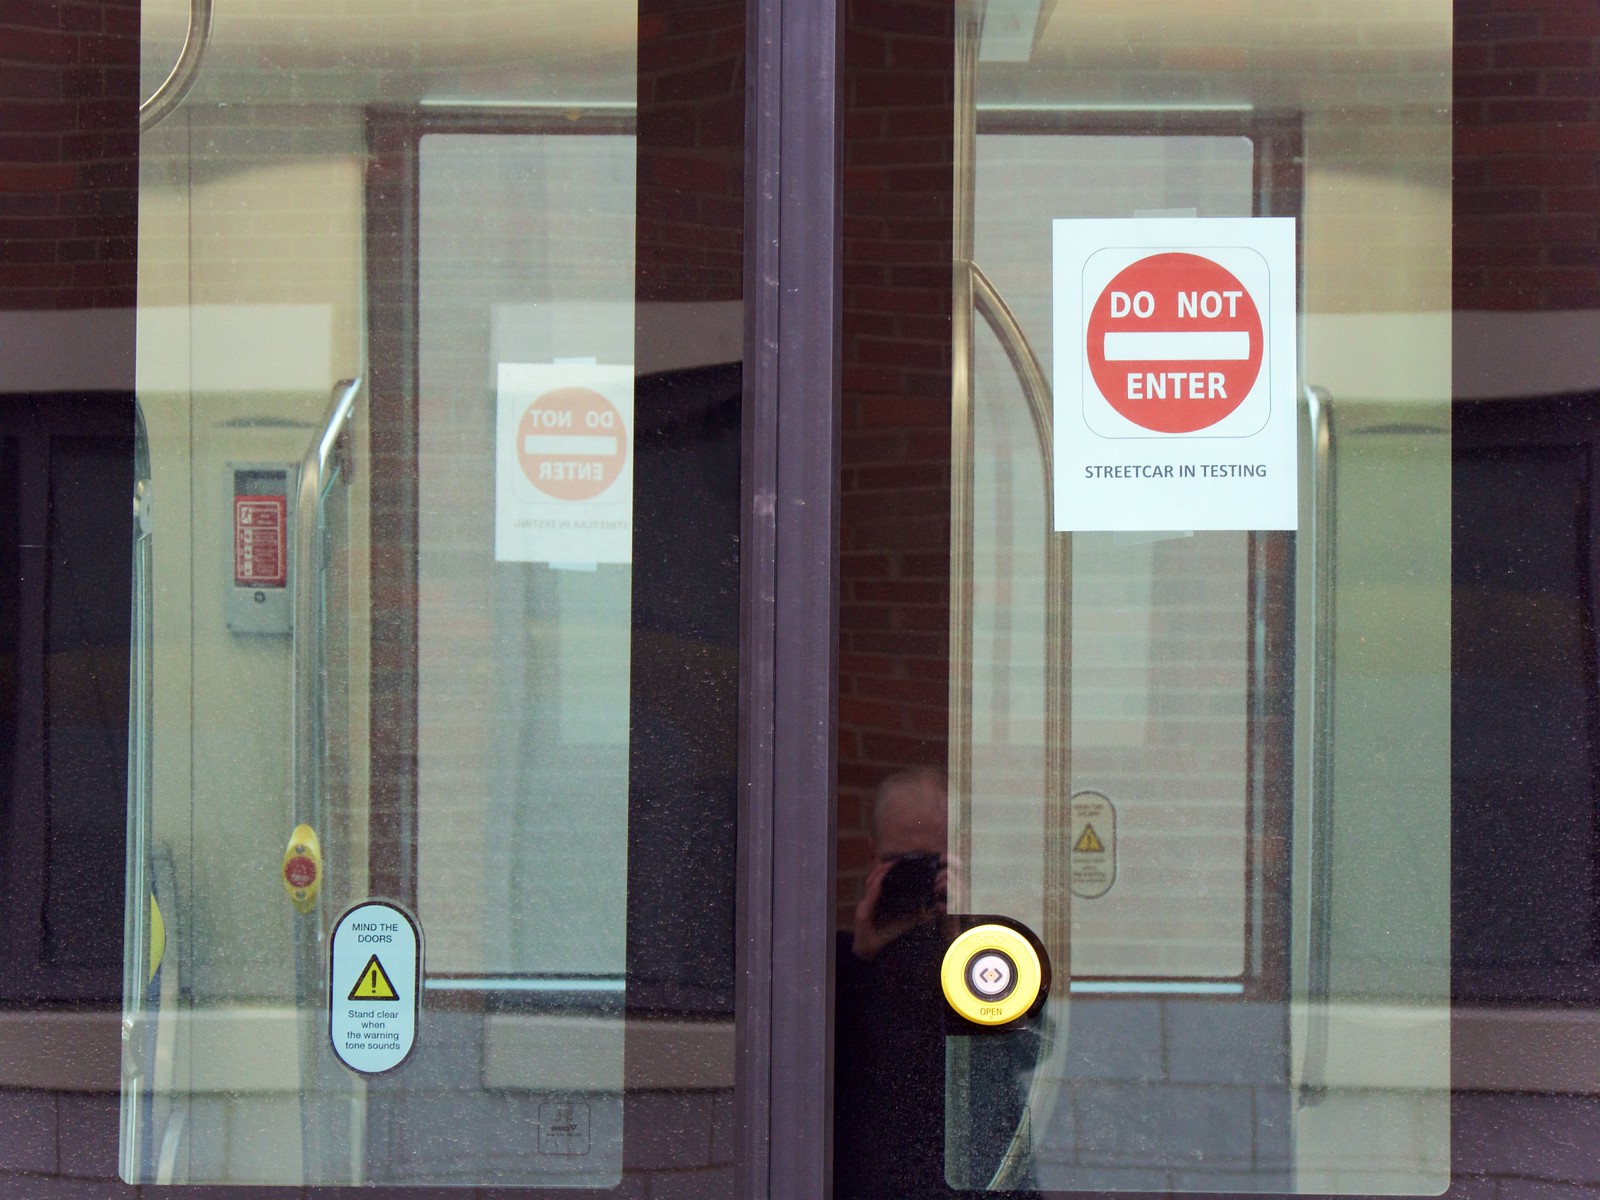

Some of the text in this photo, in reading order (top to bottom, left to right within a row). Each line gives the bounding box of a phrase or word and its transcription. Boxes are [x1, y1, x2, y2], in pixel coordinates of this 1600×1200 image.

[1110, 290, 1243, 319] DO NOT
[1126, 372, 1228, 400] ENTER
[1084, 464, 1267, 479] STREETCAR IN TESTING
[352, 923, 399, 932] MIND THE
[357, 934, 392, 943] DOORS
[348, 1010, 399, 1019] Stand clear
[979, 1007, 1003, 1016] OPEN
[361, 1021, 385, 1029] when
[347, 1031, 399, 1041] the warning
[345, 1042, 401, 1050] tone sounds
